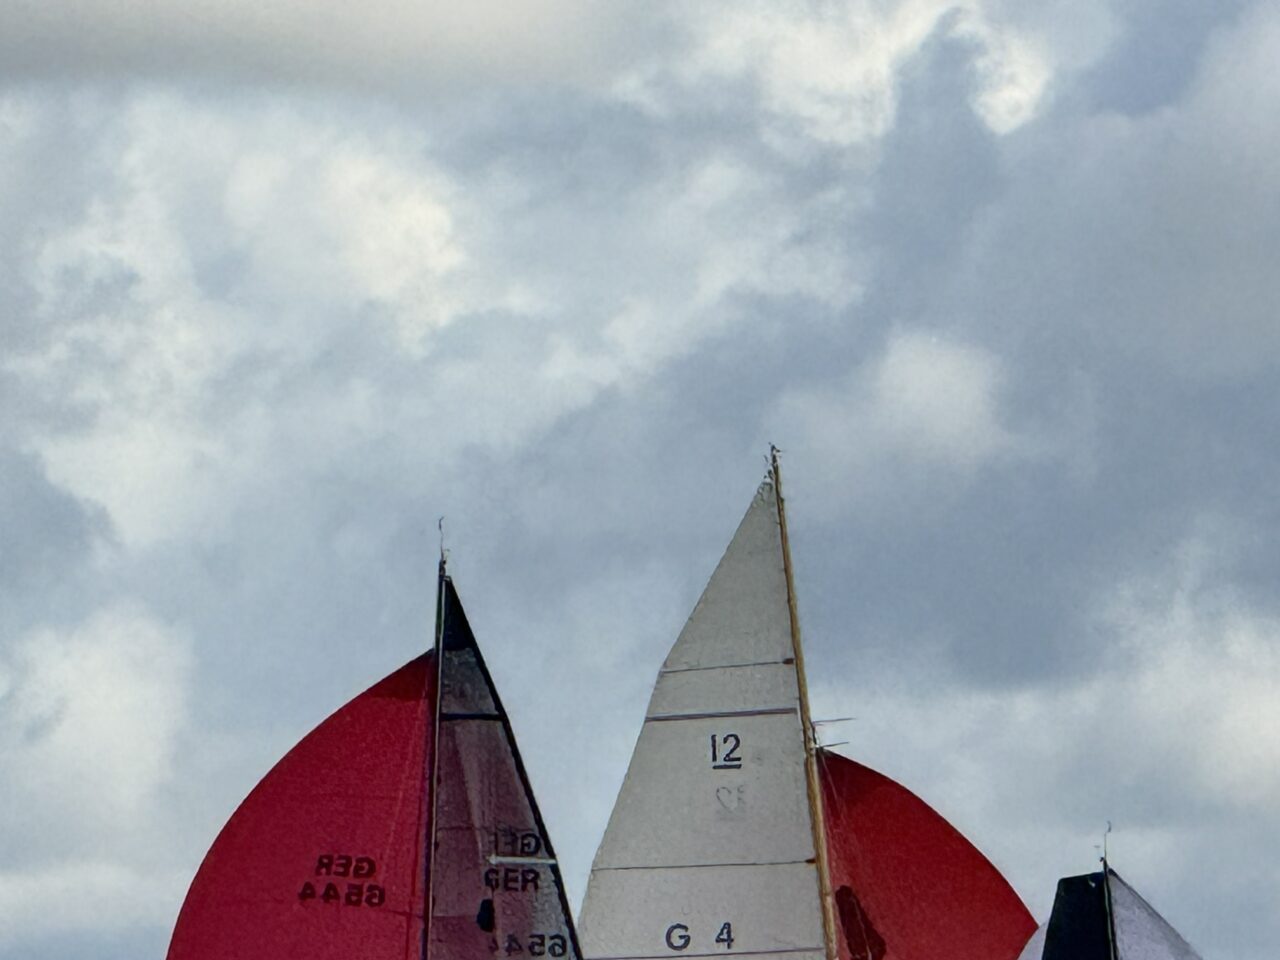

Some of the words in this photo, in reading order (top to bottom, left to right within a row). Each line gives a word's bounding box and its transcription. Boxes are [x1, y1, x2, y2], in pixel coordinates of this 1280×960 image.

[710, 733, 743, 769] 12
[484, 868, 540, 892] GER
[665, 923, 691, 951] G
[715, 922, 734, 949] 4
